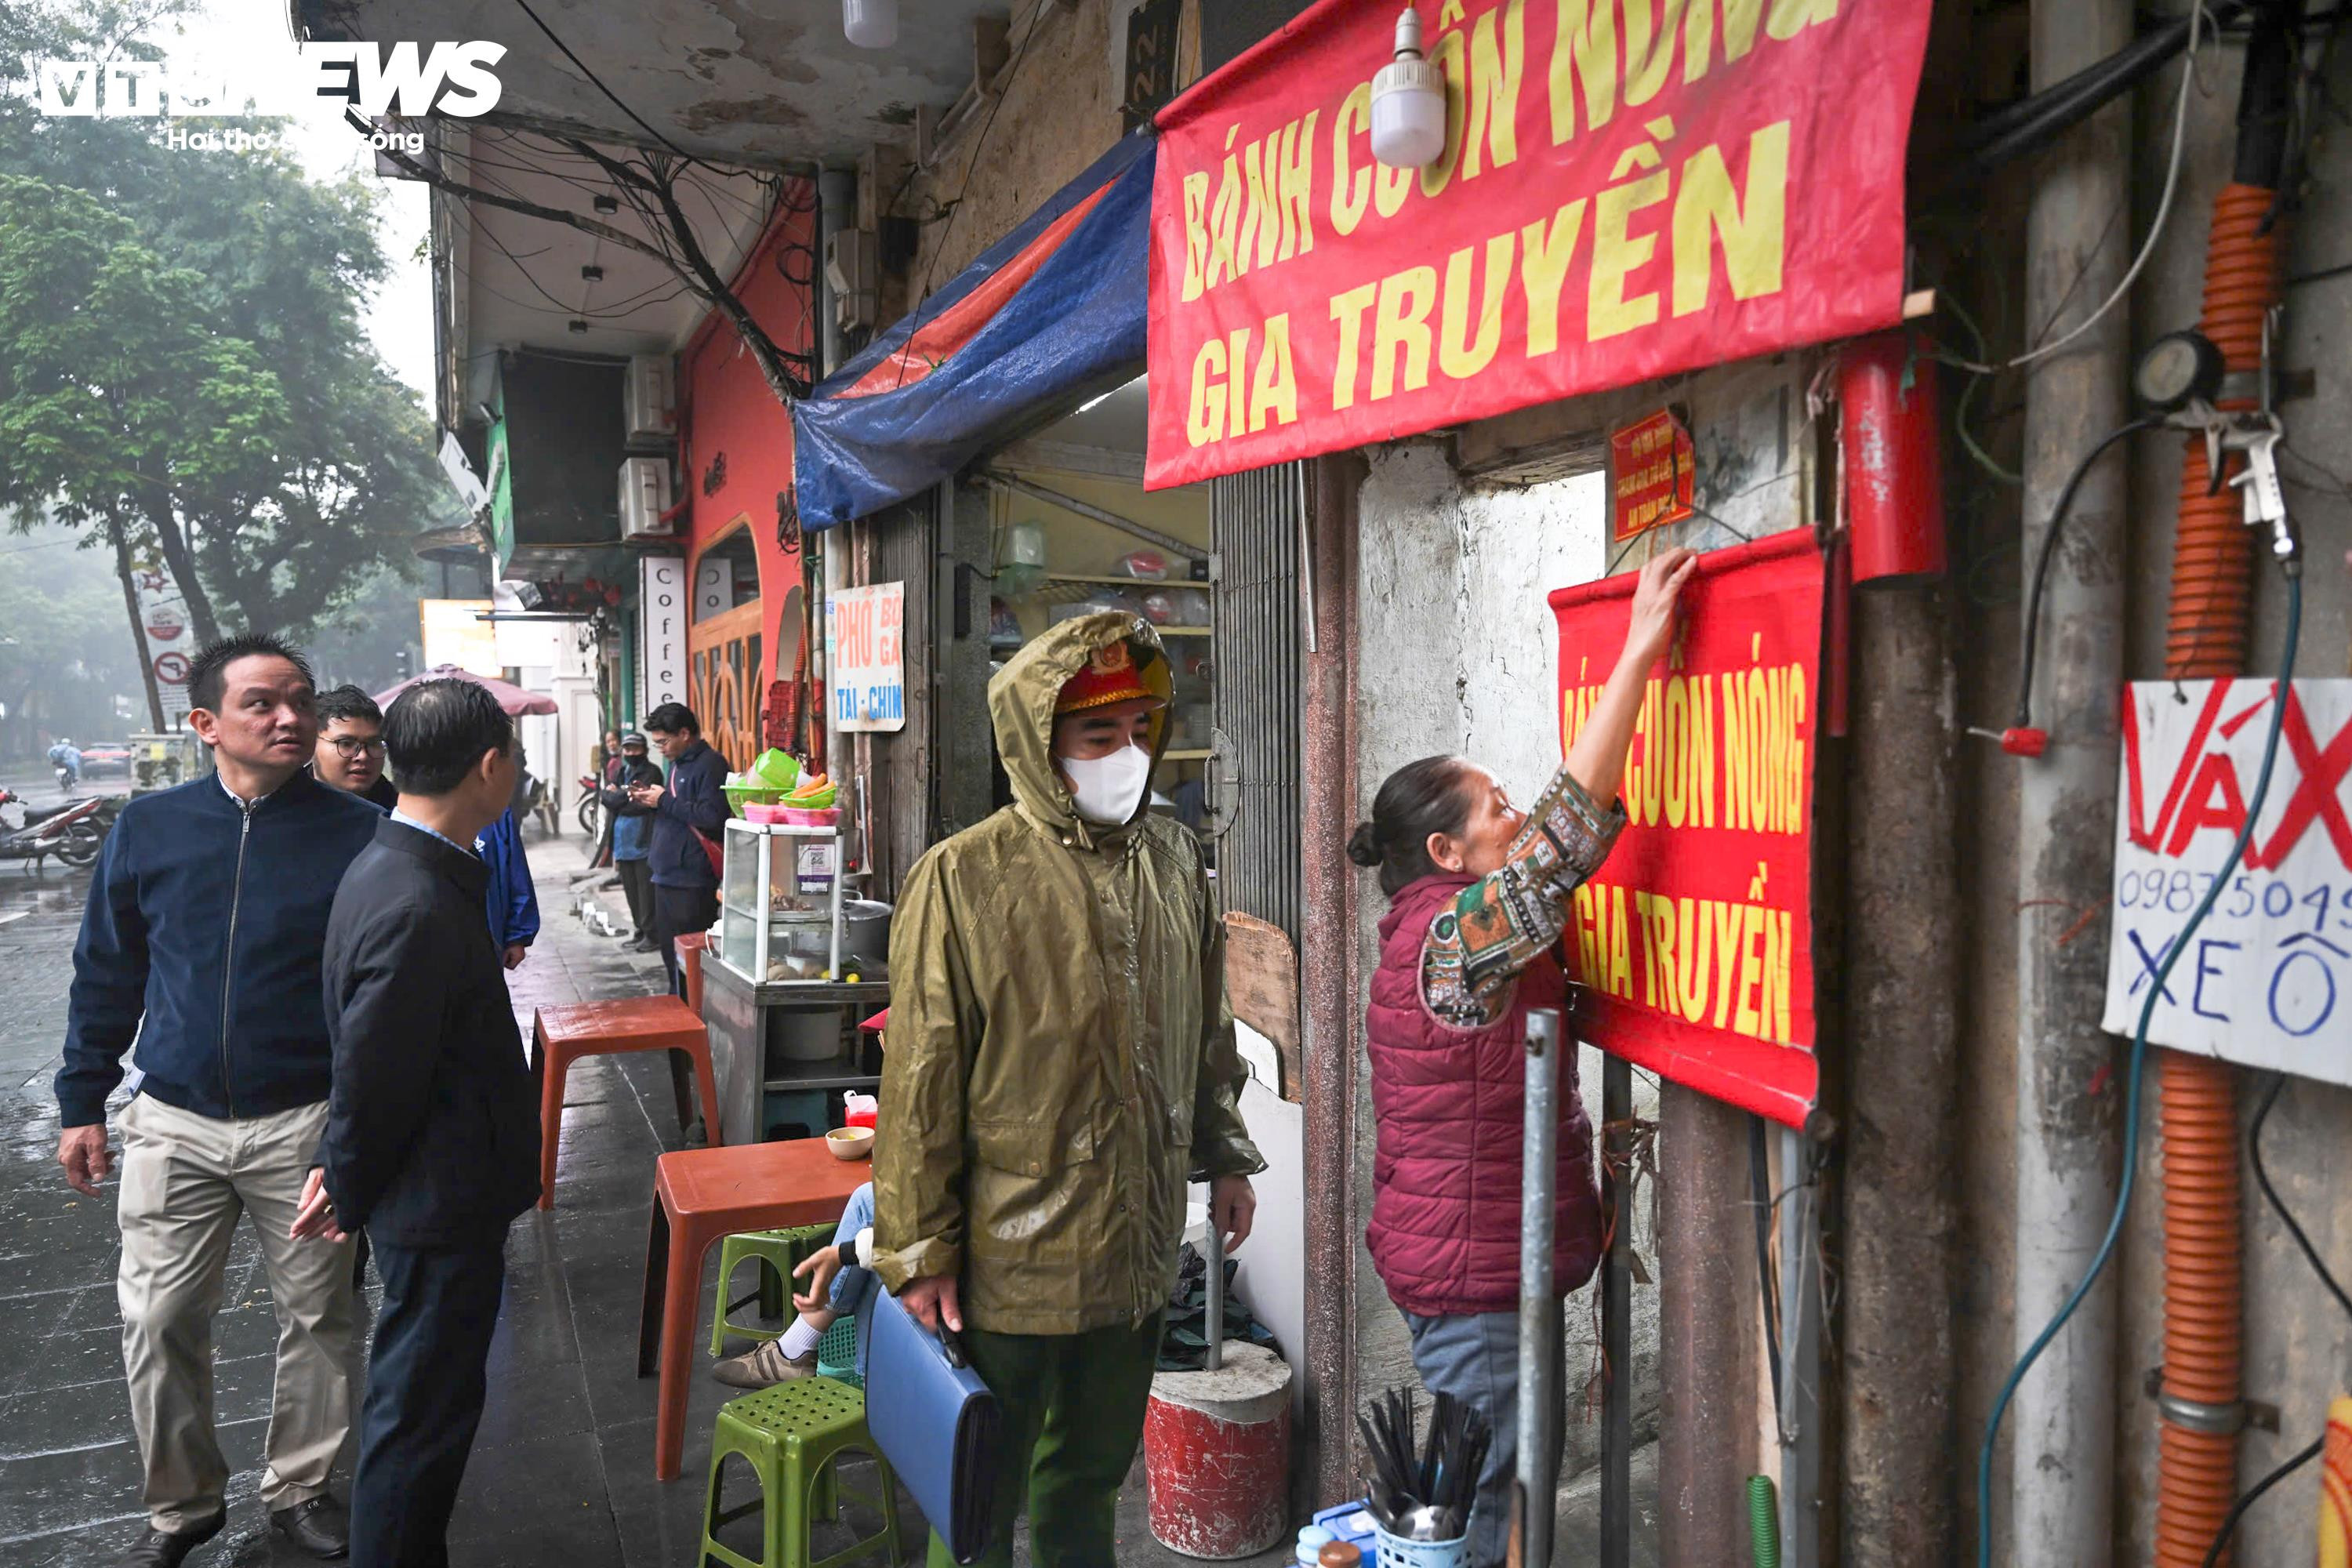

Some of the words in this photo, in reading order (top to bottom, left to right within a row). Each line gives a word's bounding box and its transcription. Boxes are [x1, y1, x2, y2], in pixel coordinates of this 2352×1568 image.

[1181, 109, 1319, 303] BÁNH
[1187, 313, 1298, 448] GIA
[1329, 114, 1791, 412] TRUYỀN
[656, 568, 674, 706] Coffee
[836, 586, 875, 669] PHỞ
[879, 630, 901, 666] GÀ
[880, 590, 902, 629] BÒ
[837, 681, 858, 720] TÁI
[869, 677, 902, 721] CHÍN
[1722, 632, 1806, 836] NÓNG
[1573, 882, 1633, 1000] GIA
[1635, 861, 1792, 1047] TRUYỀN
[2127, 929, 2241, 1023] XE
[2267, 931, 2351, 1037] Ô
